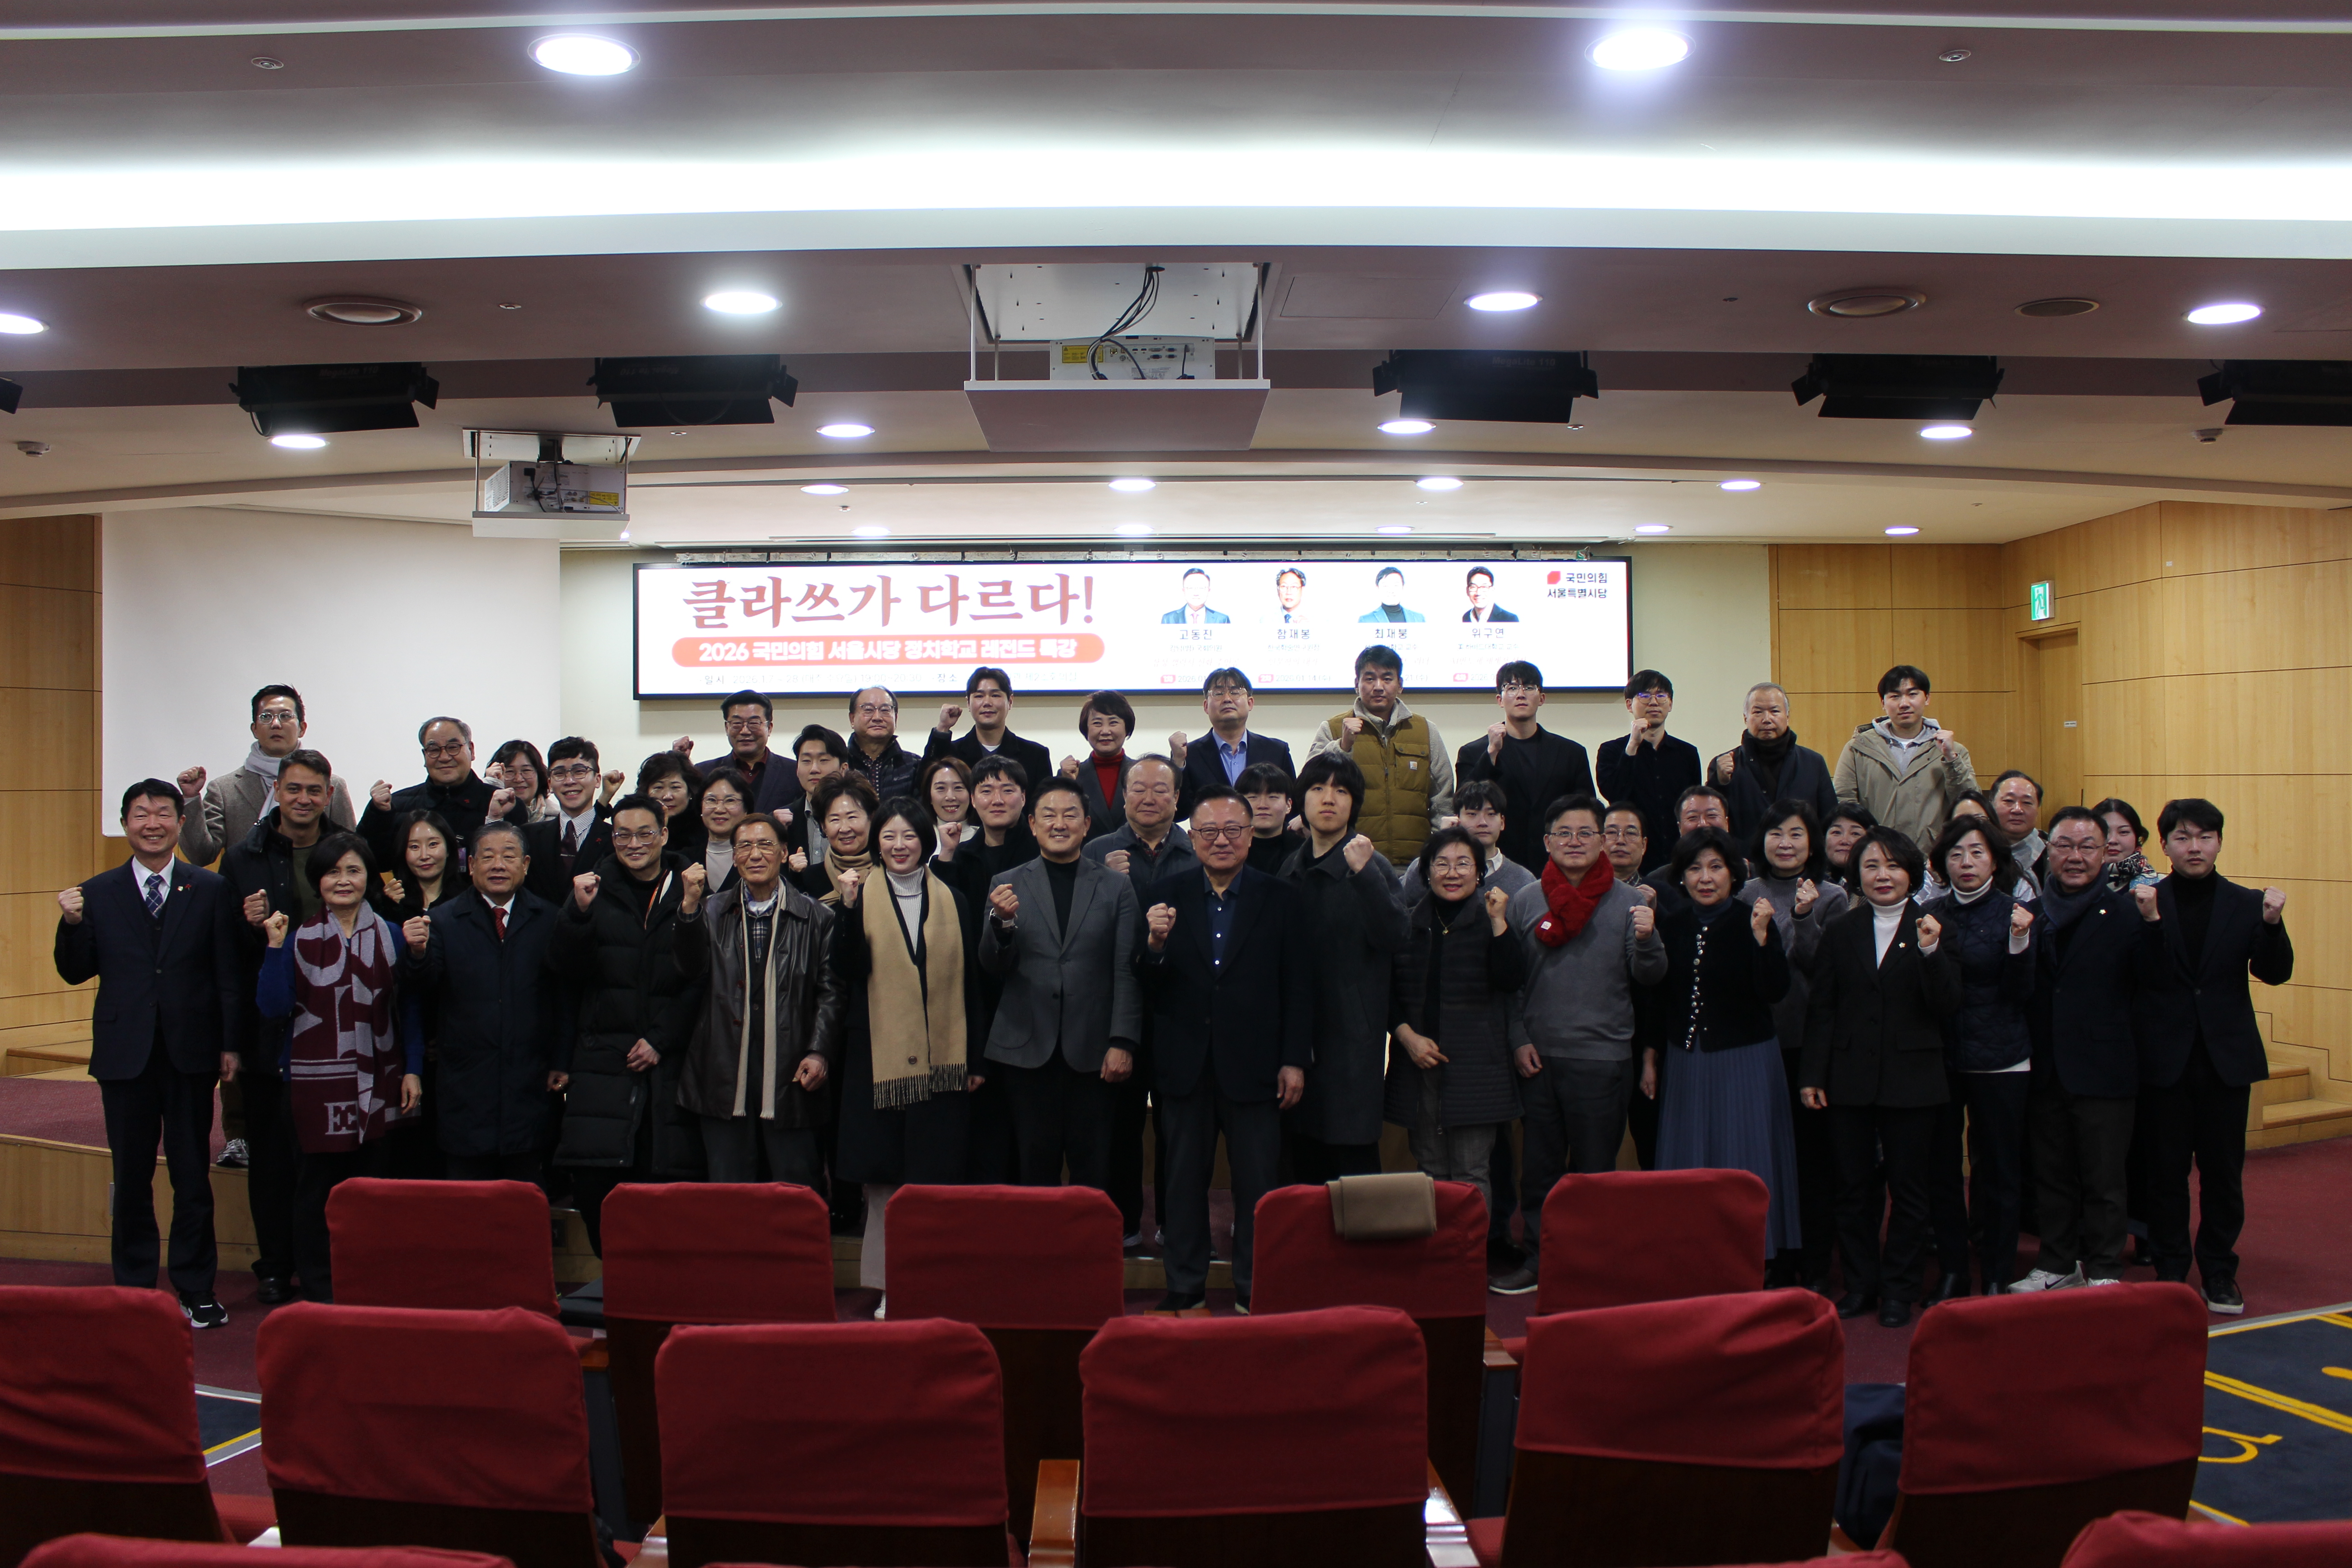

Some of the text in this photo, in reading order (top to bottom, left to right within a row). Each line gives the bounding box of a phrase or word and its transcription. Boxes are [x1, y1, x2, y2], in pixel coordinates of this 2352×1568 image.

[1492, 357, 1555, 367] MegaLite 110
[363, 365, 379, 374] 110
[1566, 572, 1607, 583] 국민의힘
[1547, 588, 1607, 598] 서울특별시당
[683, 573, 1093, 629] 클라쓰가 다르다!
[1179, 629, 1213, 640] 고동진
[1277, 628, 1311, 640] 함재봉
[1472, 628, 1504, 638] 위구연
[699, 642, 750, 661] 2026
[752, 642, 824, 661] 국민의힘
[828, 641, 901, 660] 서울시당
[905, 640, 977, 659] 정치학교
[981, 639, 1036, 658] 레전드
